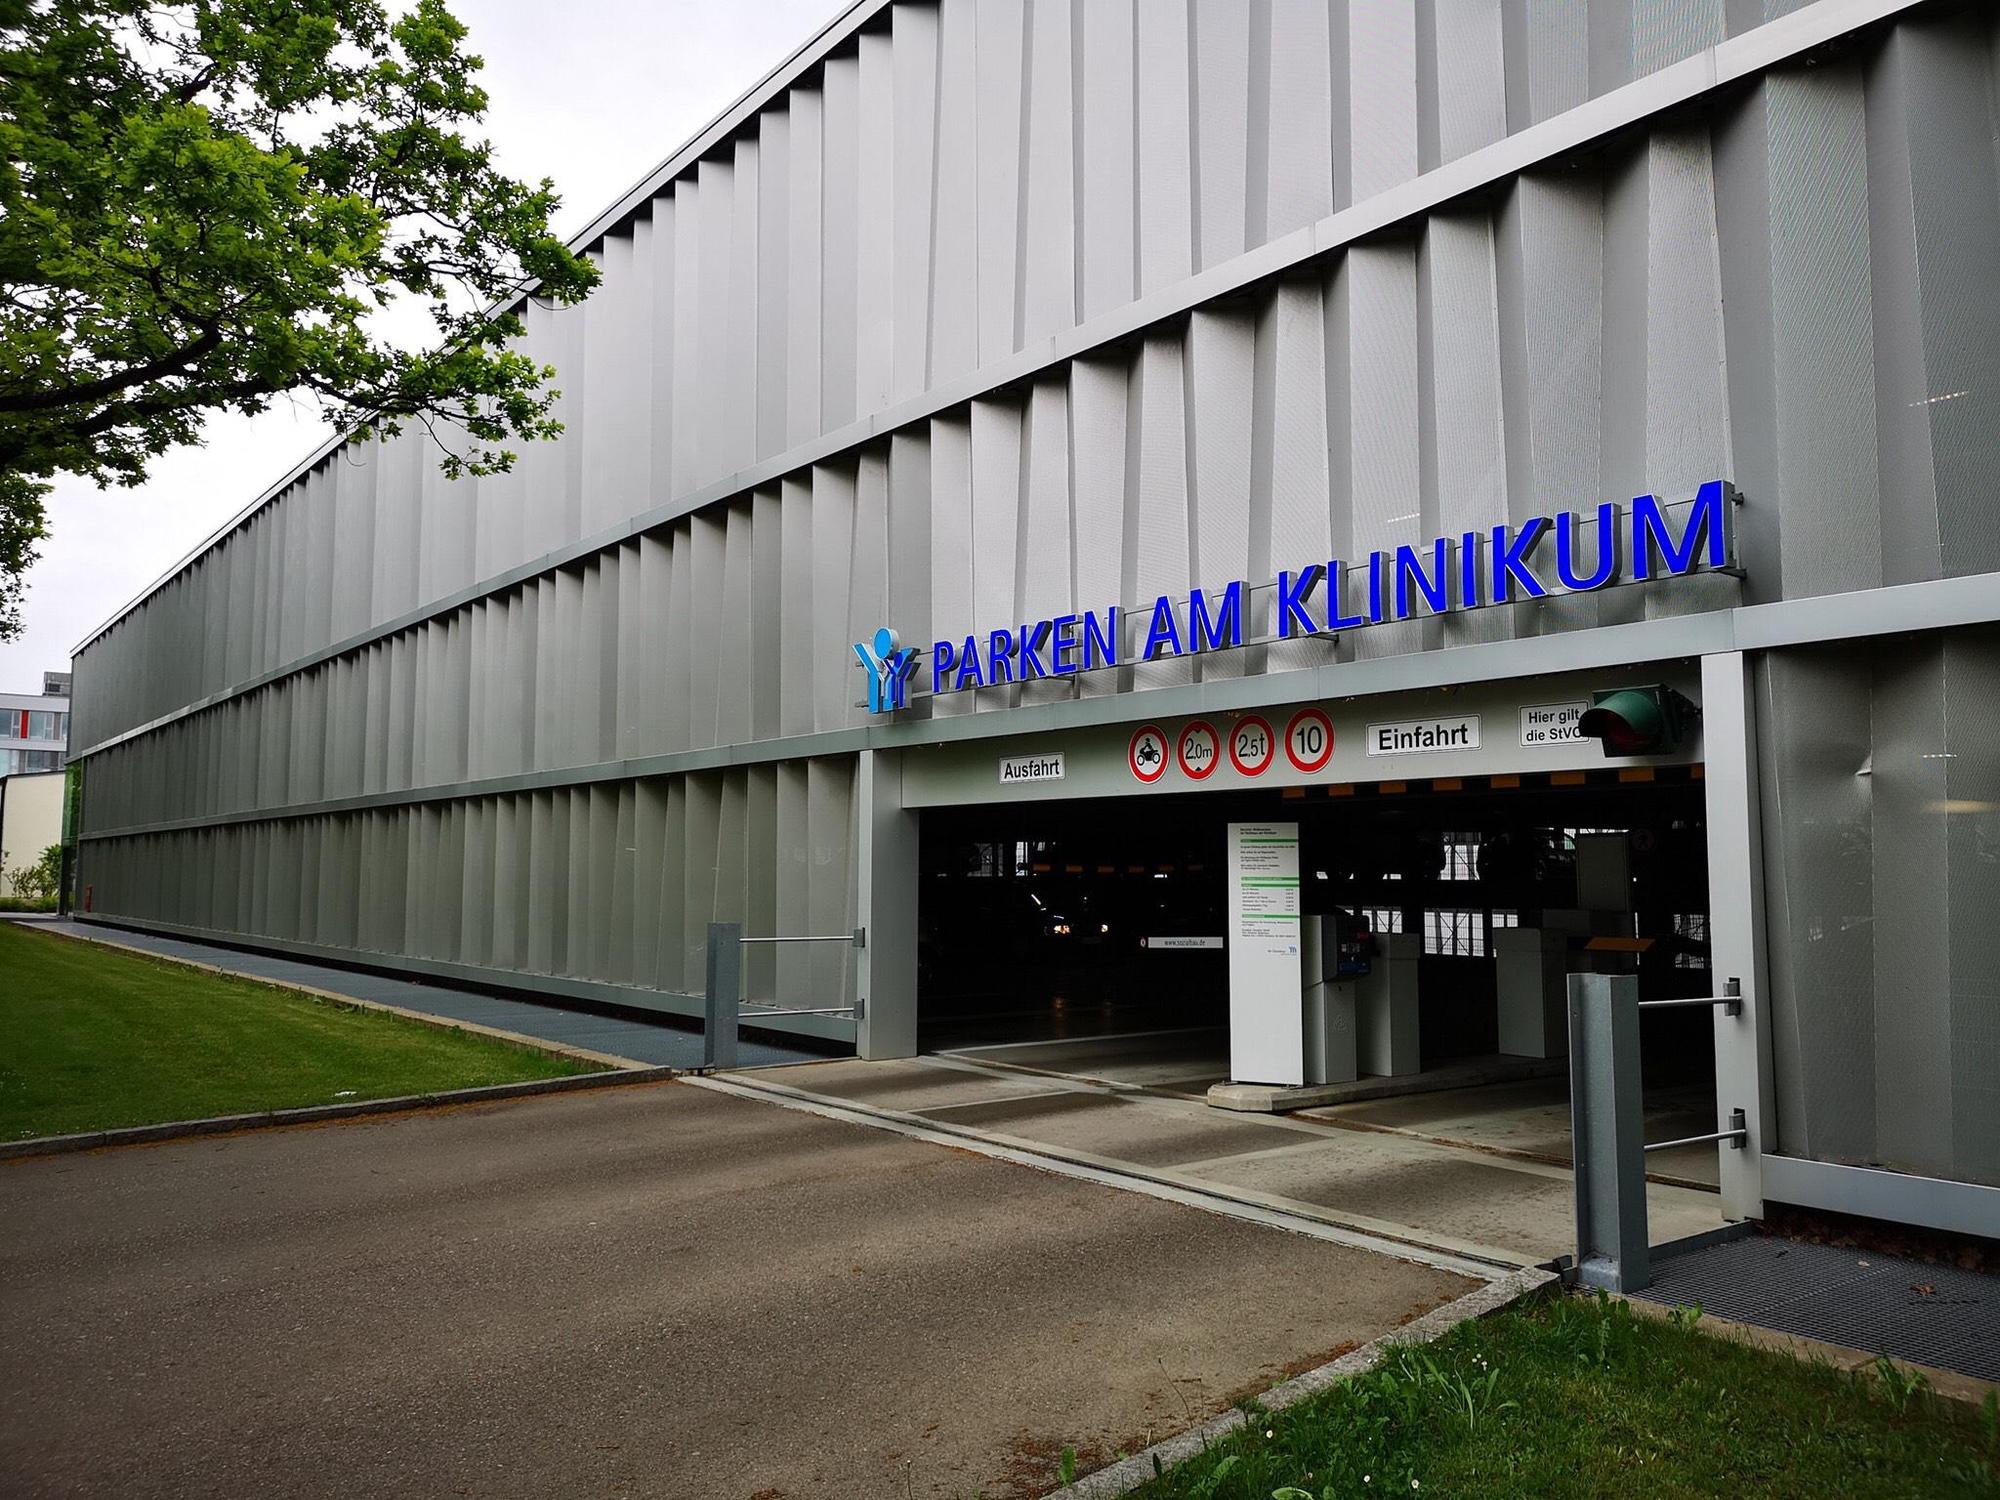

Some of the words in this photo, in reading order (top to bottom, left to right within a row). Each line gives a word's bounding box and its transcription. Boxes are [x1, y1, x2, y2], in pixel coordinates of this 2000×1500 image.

[932, 606, 1125, 694] PARKEN
[1142, 580, 1250, 662] AM
[1277, 479, 1734, 638] KLINIKUM
[1528, 711, 1555, 724] Hier
[1558, 708, 1580, 724] gilt
[1296, 726, 1322, 754] 10
[1378, 724, 1469, 751] Einfahrt
[1526, 730, 1545, 741] die
[1003, 758, 1061, 780] Ausfahrt
